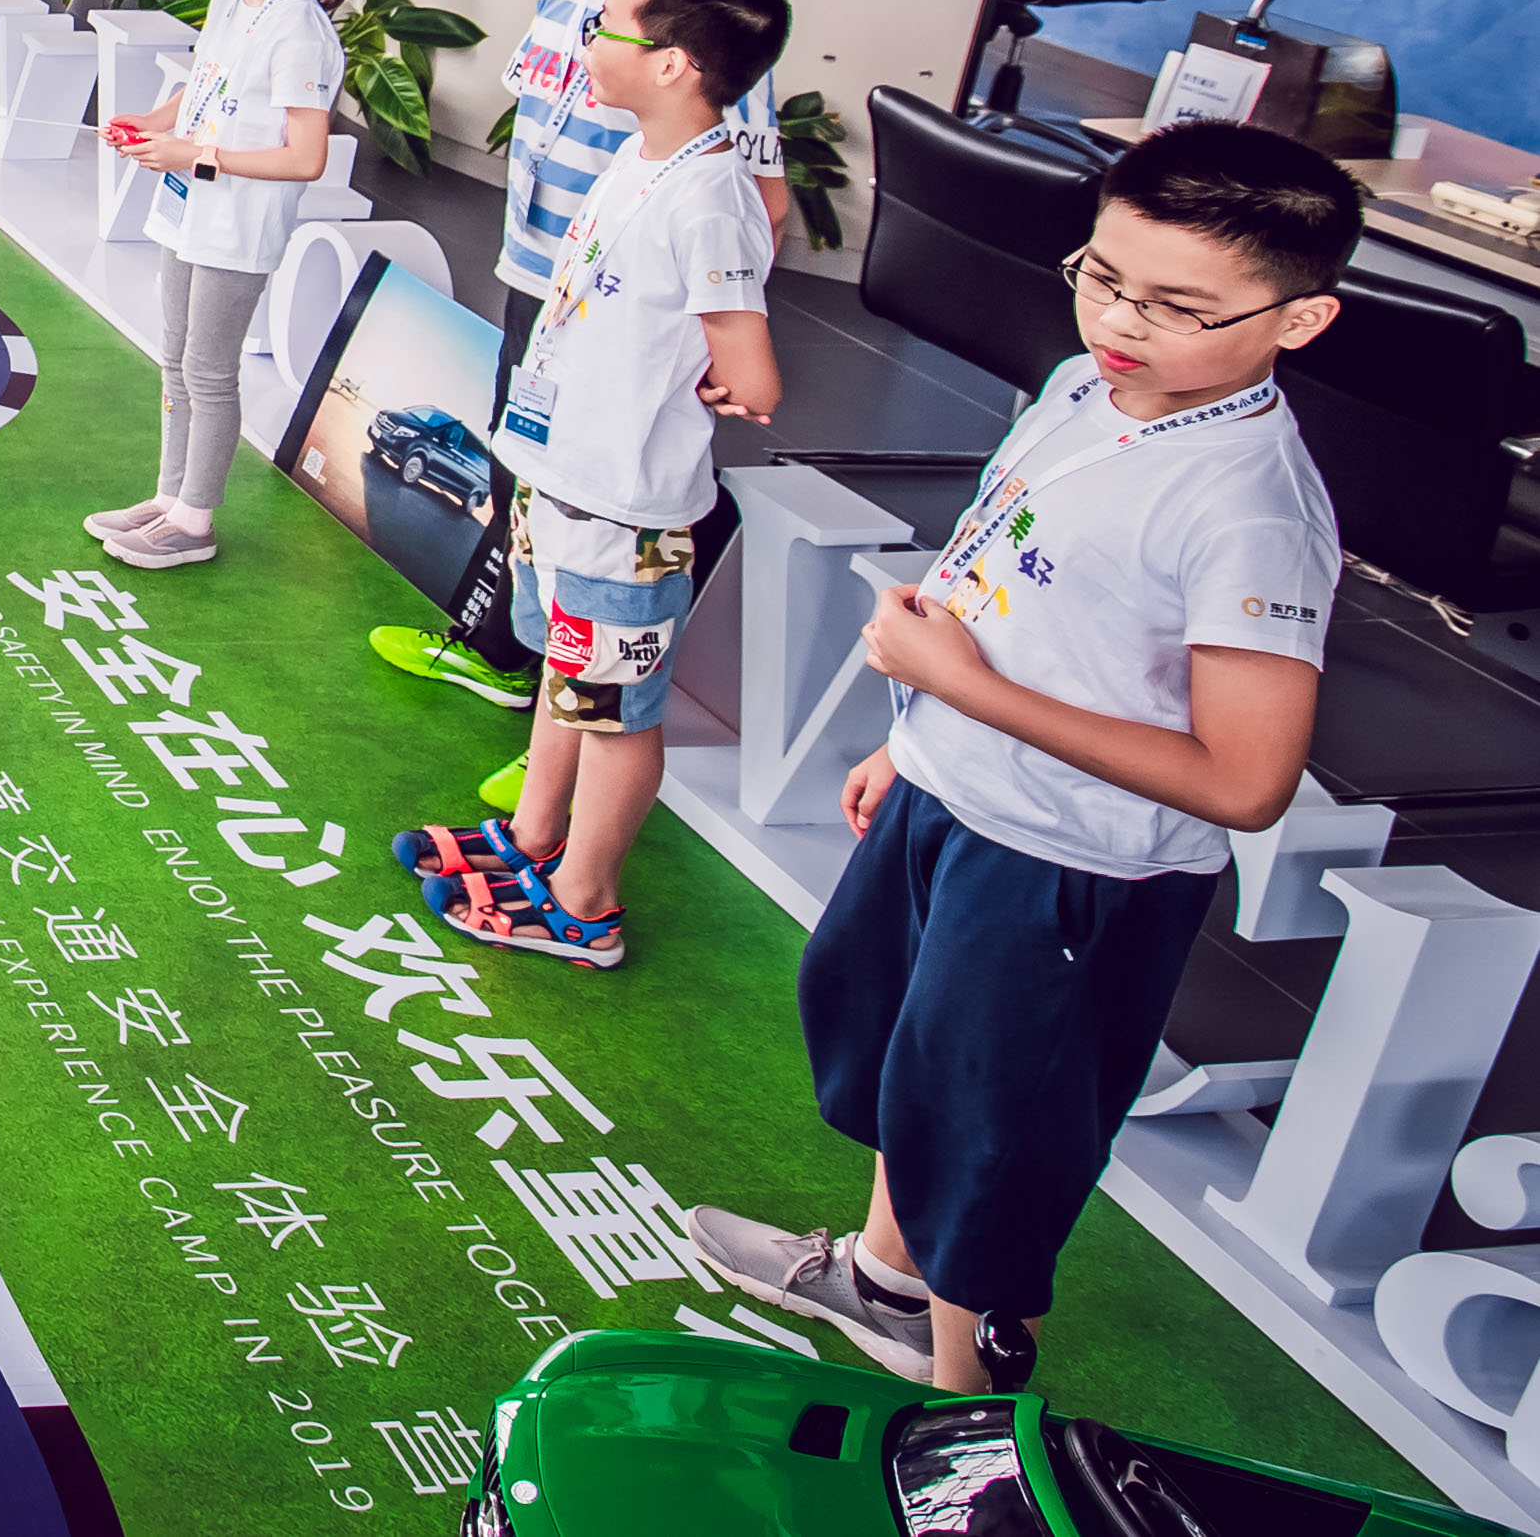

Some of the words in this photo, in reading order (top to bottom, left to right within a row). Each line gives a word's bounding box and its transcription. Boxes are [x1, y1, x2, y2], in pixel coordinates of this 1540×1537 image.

[5, 569, 346, 888] 安全在心
[51, 711, 95, 734] IN
[74, 742, 150, 808] MIND
[142, 829, 246, 924] ENJOY
[226, 931, 303, 997] THE
[279, 1007, 465, 1203] PLEASURE
[139, 1177, 238, 1295] CAMP
[223, 1319, 283, 1362] IN
[268, 1390, 374, 1511] 2019
